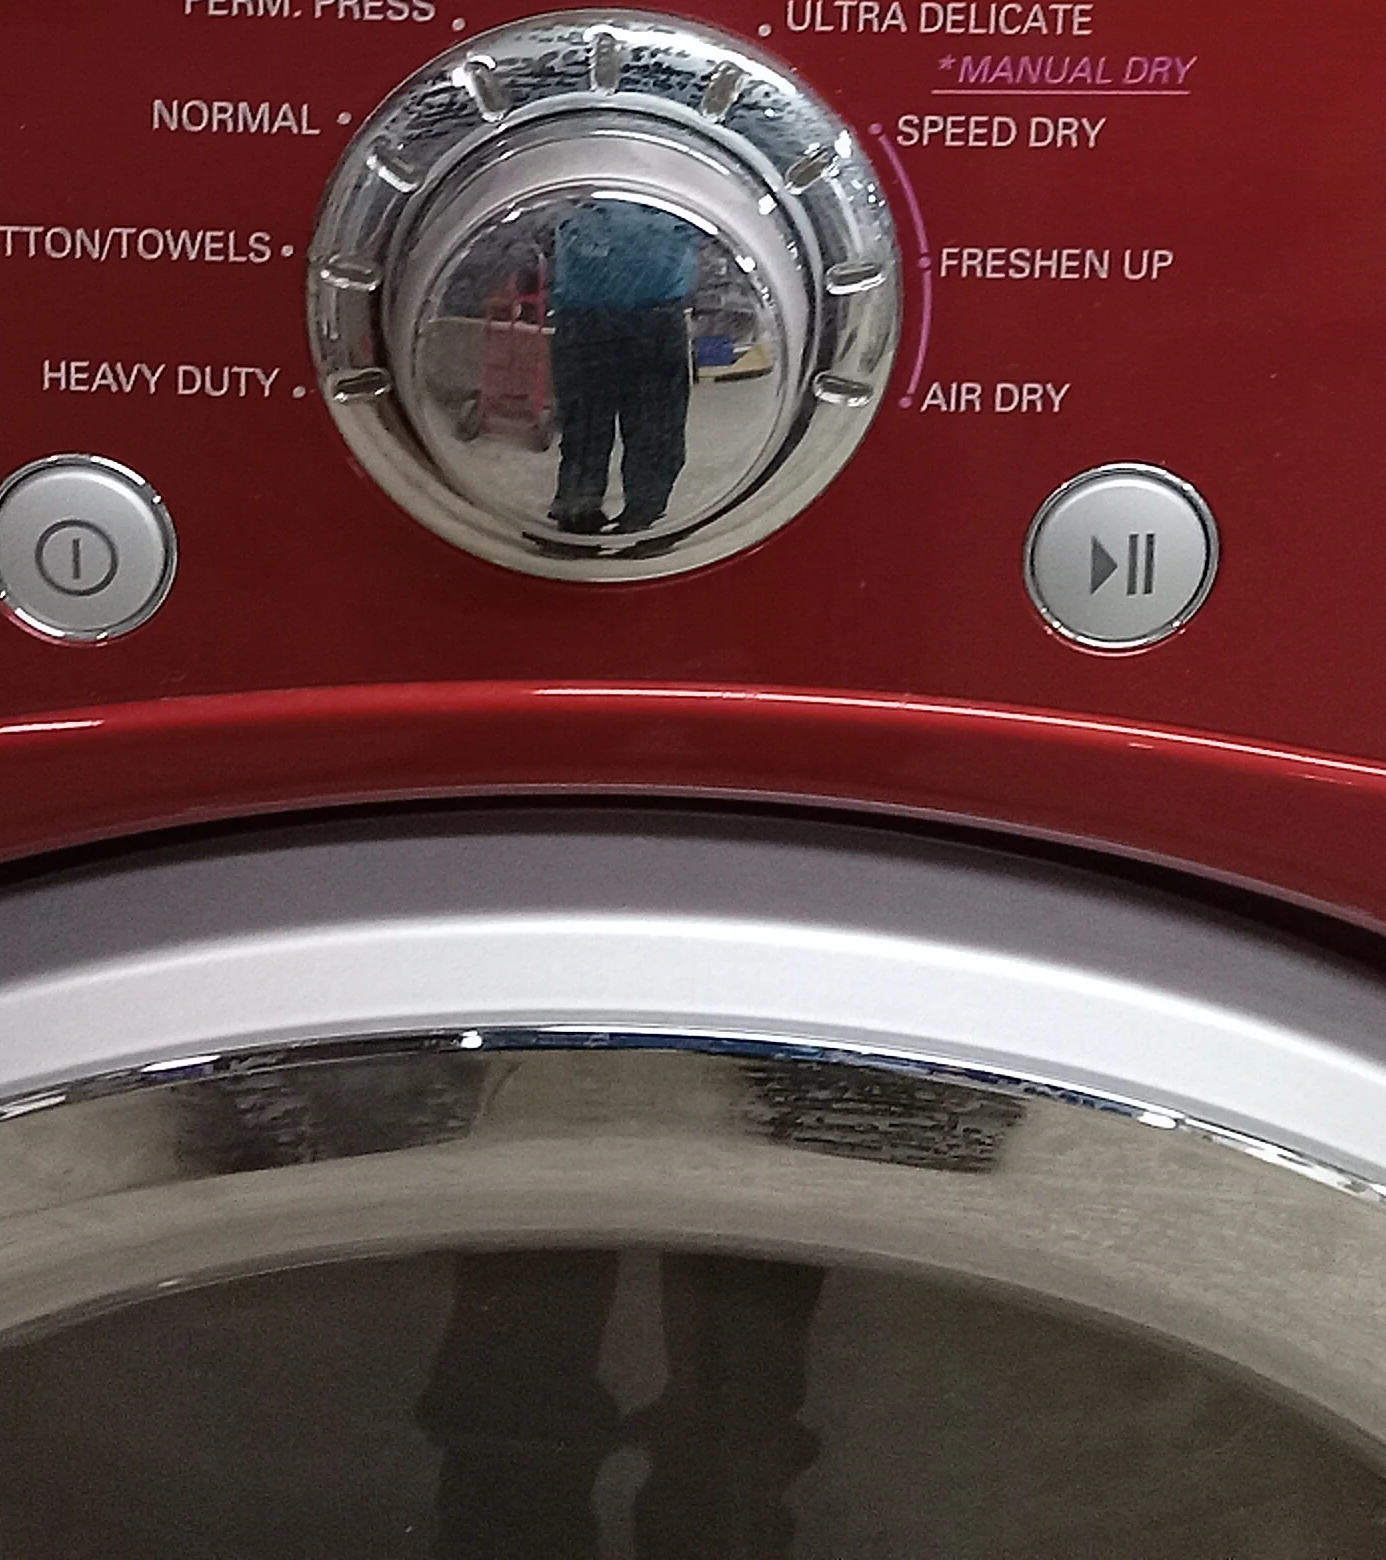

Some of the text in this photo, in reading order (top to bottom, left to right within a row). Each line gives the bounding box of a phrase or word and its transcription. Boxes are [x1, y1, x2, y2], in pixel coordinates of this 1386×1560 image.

[786, 0, 1093, 36] ULTRA DELICATE
[1122, 55, 1198, 85] DRY
[152, 99, 321, 135] NORMAL
[896, 114, 1106, 148] SPEED DRY
[940, 247, 1174, 280] FRESHEN UP
[43, 359, 280, 397] HEAVY DUTY
[920, 381, 1071, 413] AIR DRY
